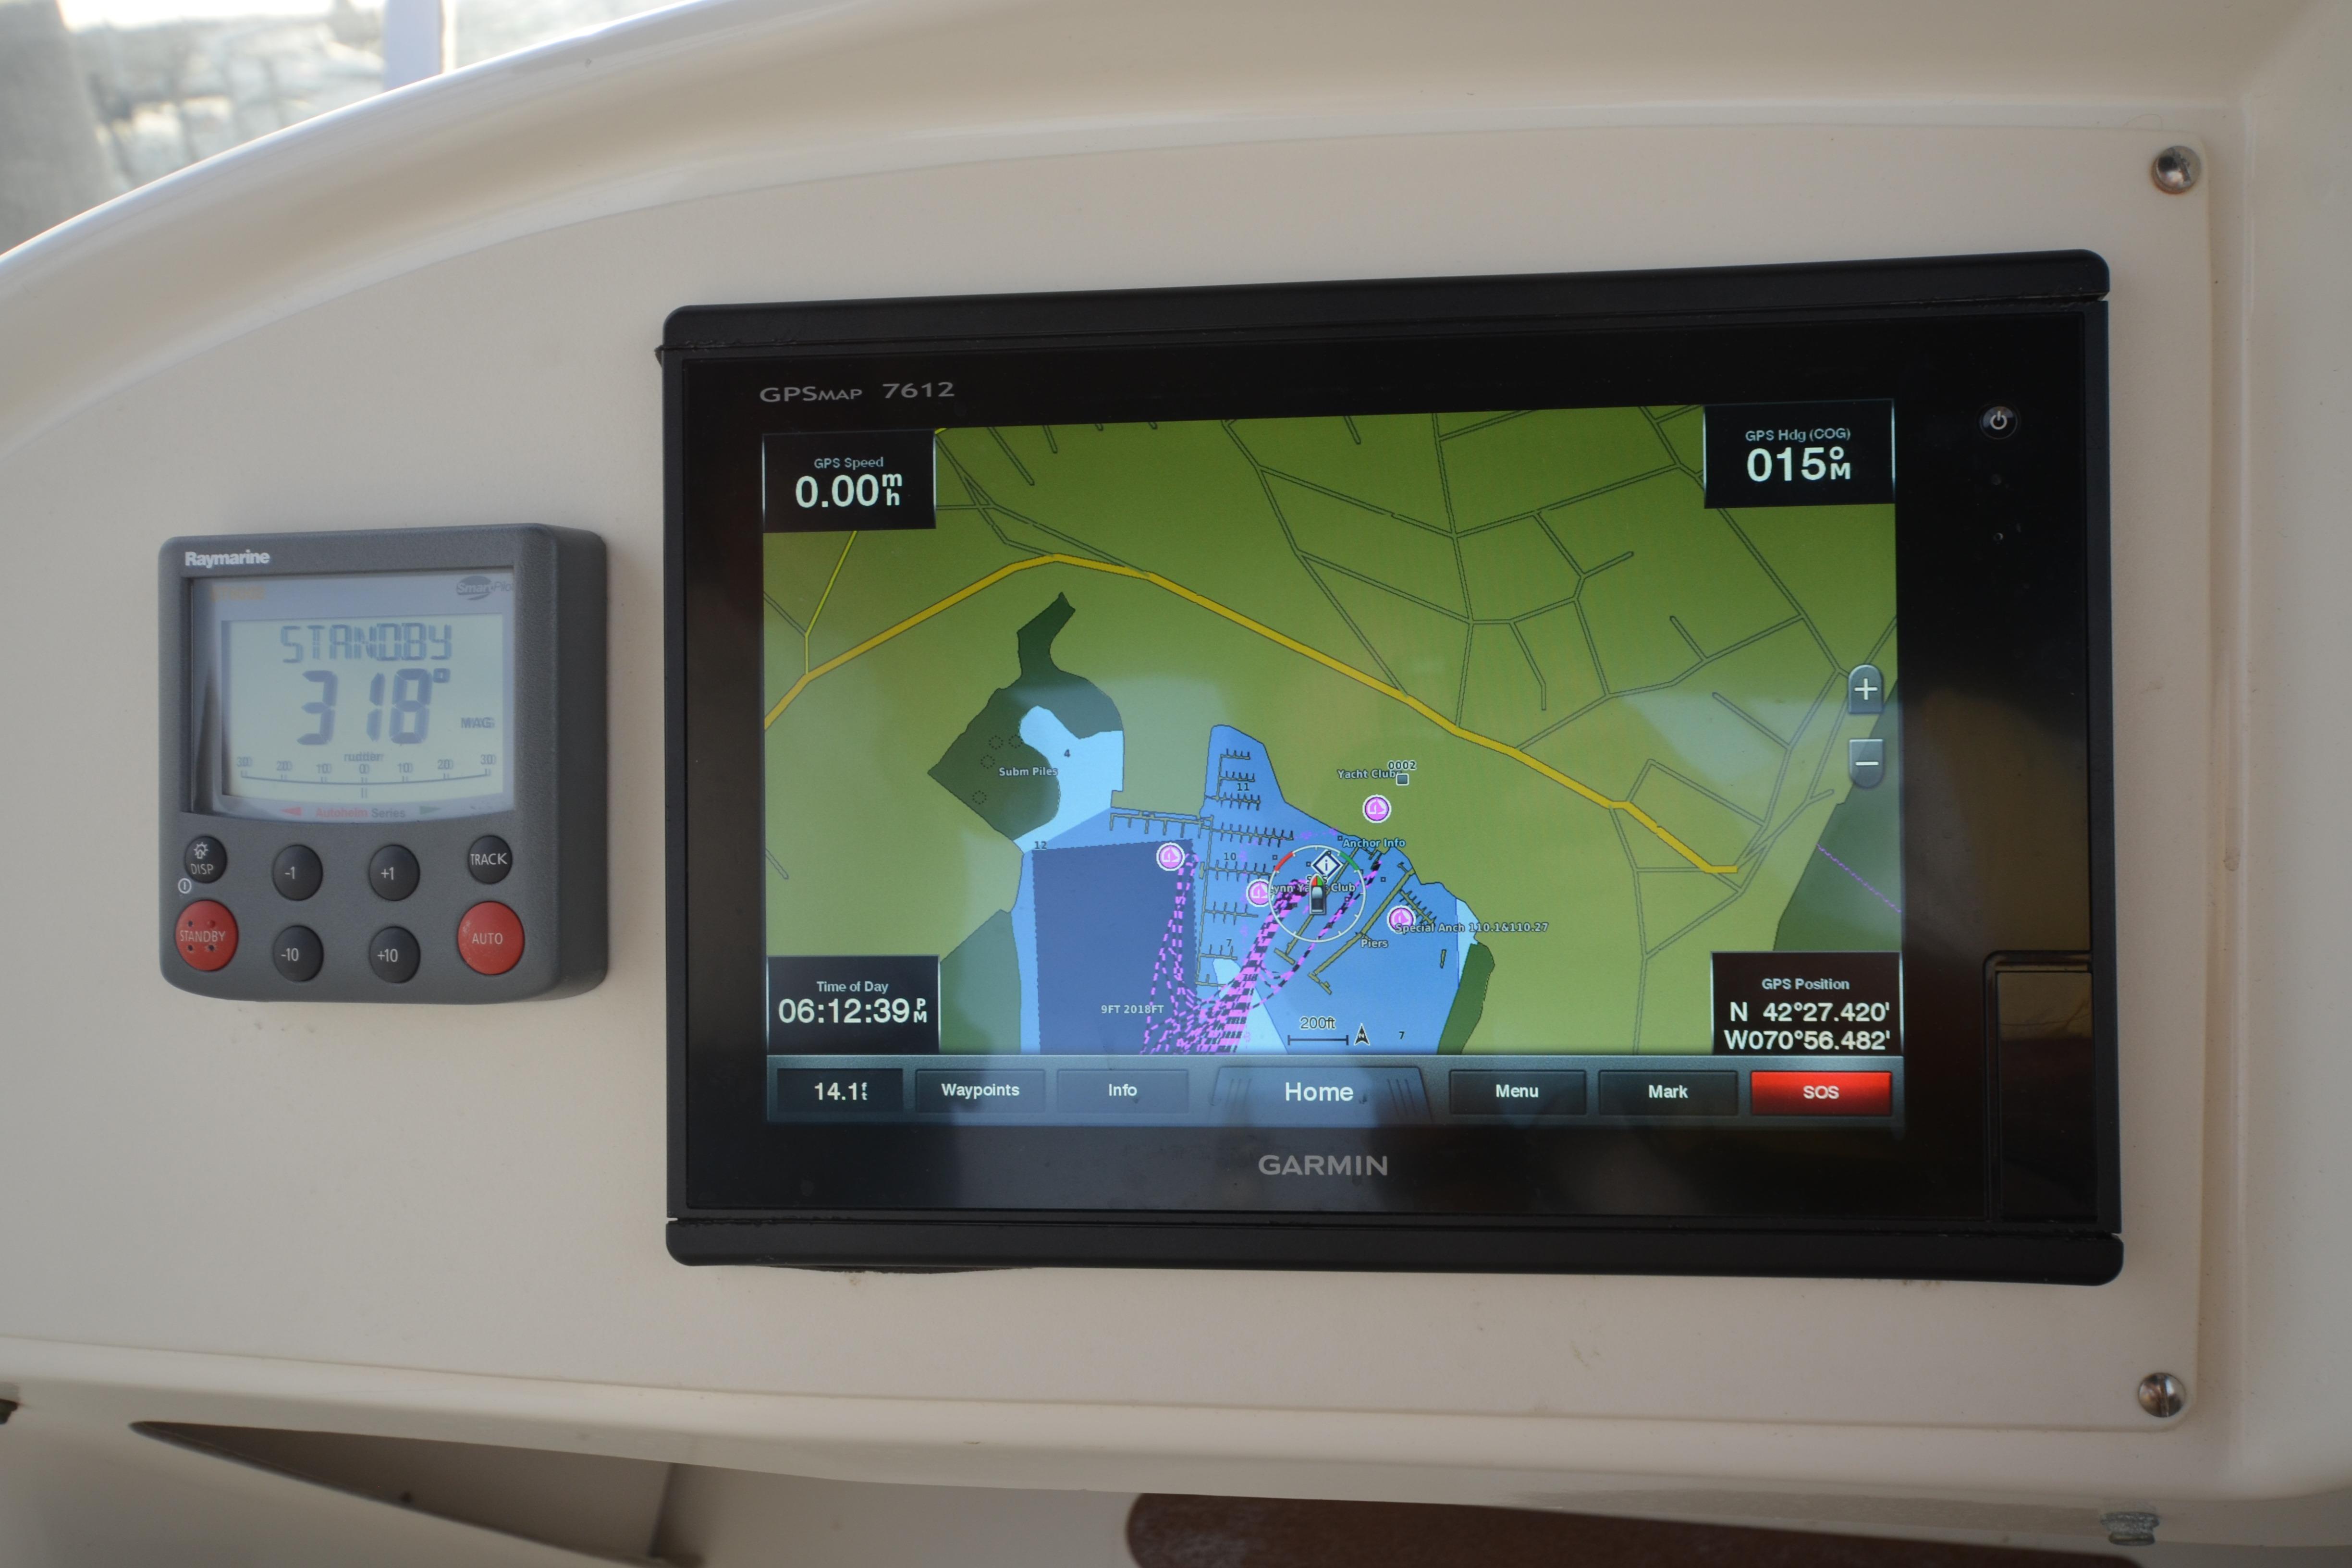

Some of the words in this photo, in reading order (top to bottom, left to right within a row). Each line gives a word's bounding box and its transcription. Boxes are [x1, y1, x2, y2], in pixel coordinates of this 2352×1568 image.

[760, 386, 863, 402] GPSMAP
[882, 381, 955, 399] 7612
[1746, 430, 1774, 442] GPS
[1778, 429, 1806, 443] Hdg
[1809, 428, 1851, 441] (COG)
[814, 458, 840, 469] GPS
[844, 456, 884, 470] Speed
[185, 549, 270, 569] Raymarine
[280, 623, 452, 663] STANDBY
[461, 717, 495, 730] MAG
[344, 752, 383, 762] rudder
[1064, 749, 1071, 758] 4
[999, 767, 1029, 776] Subm
[1032, 767, 1058, 776] Piles
[1387, 760, 1417, 770] 0002
[1337, 770, 1368, 779] Yacht
[1237, 783, 1250, 791] 11
[371, 808, 406, 819] Series
[1034, 841, 1047, 850] 12
[1343, 838, 1381, 847] Anchor
[1384, 838, 1406, 847] Info
[470, 852, 508, 867] TRACK
[1224, 853, 1237, 861] 10
[191, 863, 214, 875] DISP
[284, 867, 296, 880] -1
[380, 867, 395, 881] +1
[1331, 883, 1356, 892] Club
[1395, 923, 1435, 933] Special
[1438, 923, 1465, 932] Anch
[1469, 922, 1549, 932] 110.1&110.27
[179, 930, 226, 943] STANDBY
[472, 933, 503, 945] AUTO
[1226, 939, 1232, 947] 7
[1360, 939, 1389, 948] Piers
[281, 948, 299, 962] -10
[377, 948, 398, 963] +10
[817, 981, 846, 992] Time
[849, 981, 861, 992] of
[864, 981, 889, 994] Day
[1762, 978, 1791, 991] GPS
[1795, 978, 1850, 991] Position
[778, 998, 910, 1023] 06:12:39
[1101, 1004, 1121, 1014] 9FT
[1124, 1004, 1164, 1014] 2018FT
[1730, 1002, 1748, 1022] N
[1299, 1016, 1336, 1030] 200ft
[1398, 1031, 1405, 1040] 7
[941, 1083, 1020, 1100] Waypoints
[1108, 1083, 1138, 1097] Info
[1285, 1081, 1354, 1102] Home
[1495, 1083, 1539, 1099] Menu
[1648, 1084, 1689, 1099] Mark
[1802, 1085, 1839, 1100] SOS
[1258, 1154, 1388, 1176] GARMIN
